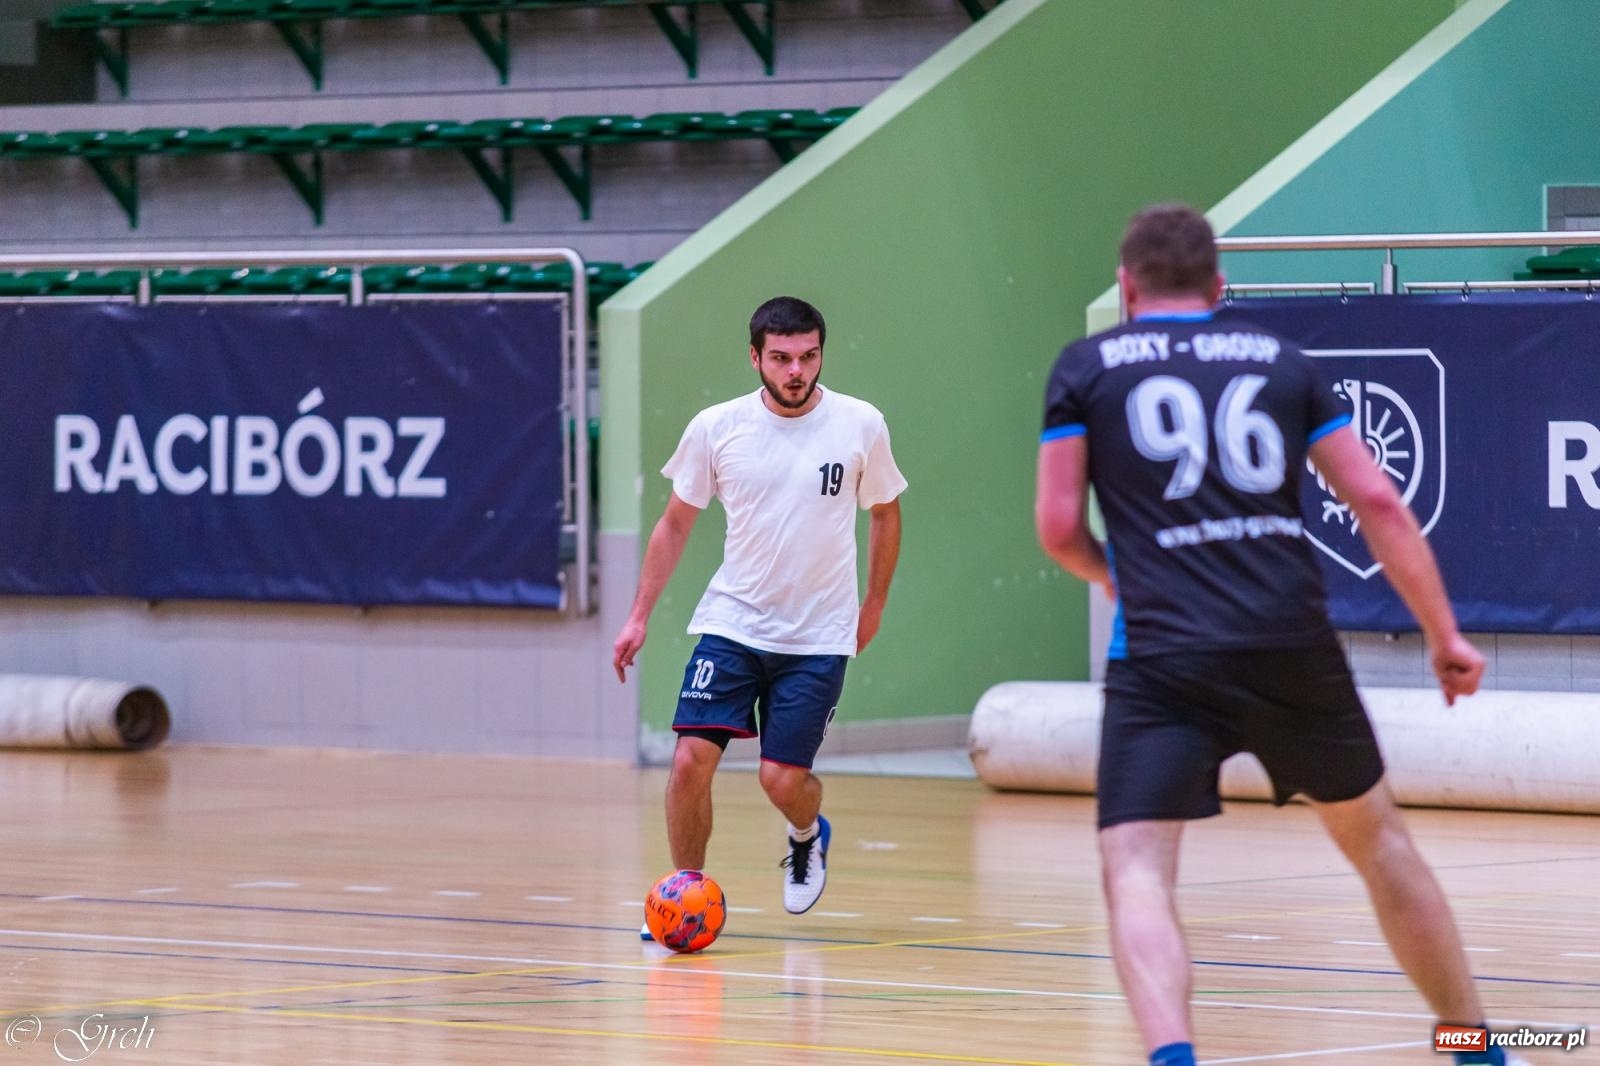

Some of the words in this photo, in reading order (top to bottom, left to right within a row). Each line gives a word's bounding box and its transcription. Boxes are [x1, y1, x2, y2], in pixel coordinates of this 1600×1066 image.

[1099, 332, 1170, 369] BOXY
[54, 387, 447, 498] RACIBÓRZ
[1125, 374, 1287, 501] 96
[819, 462, 844, 497] 19
[691, 658, 714, 690] 10
